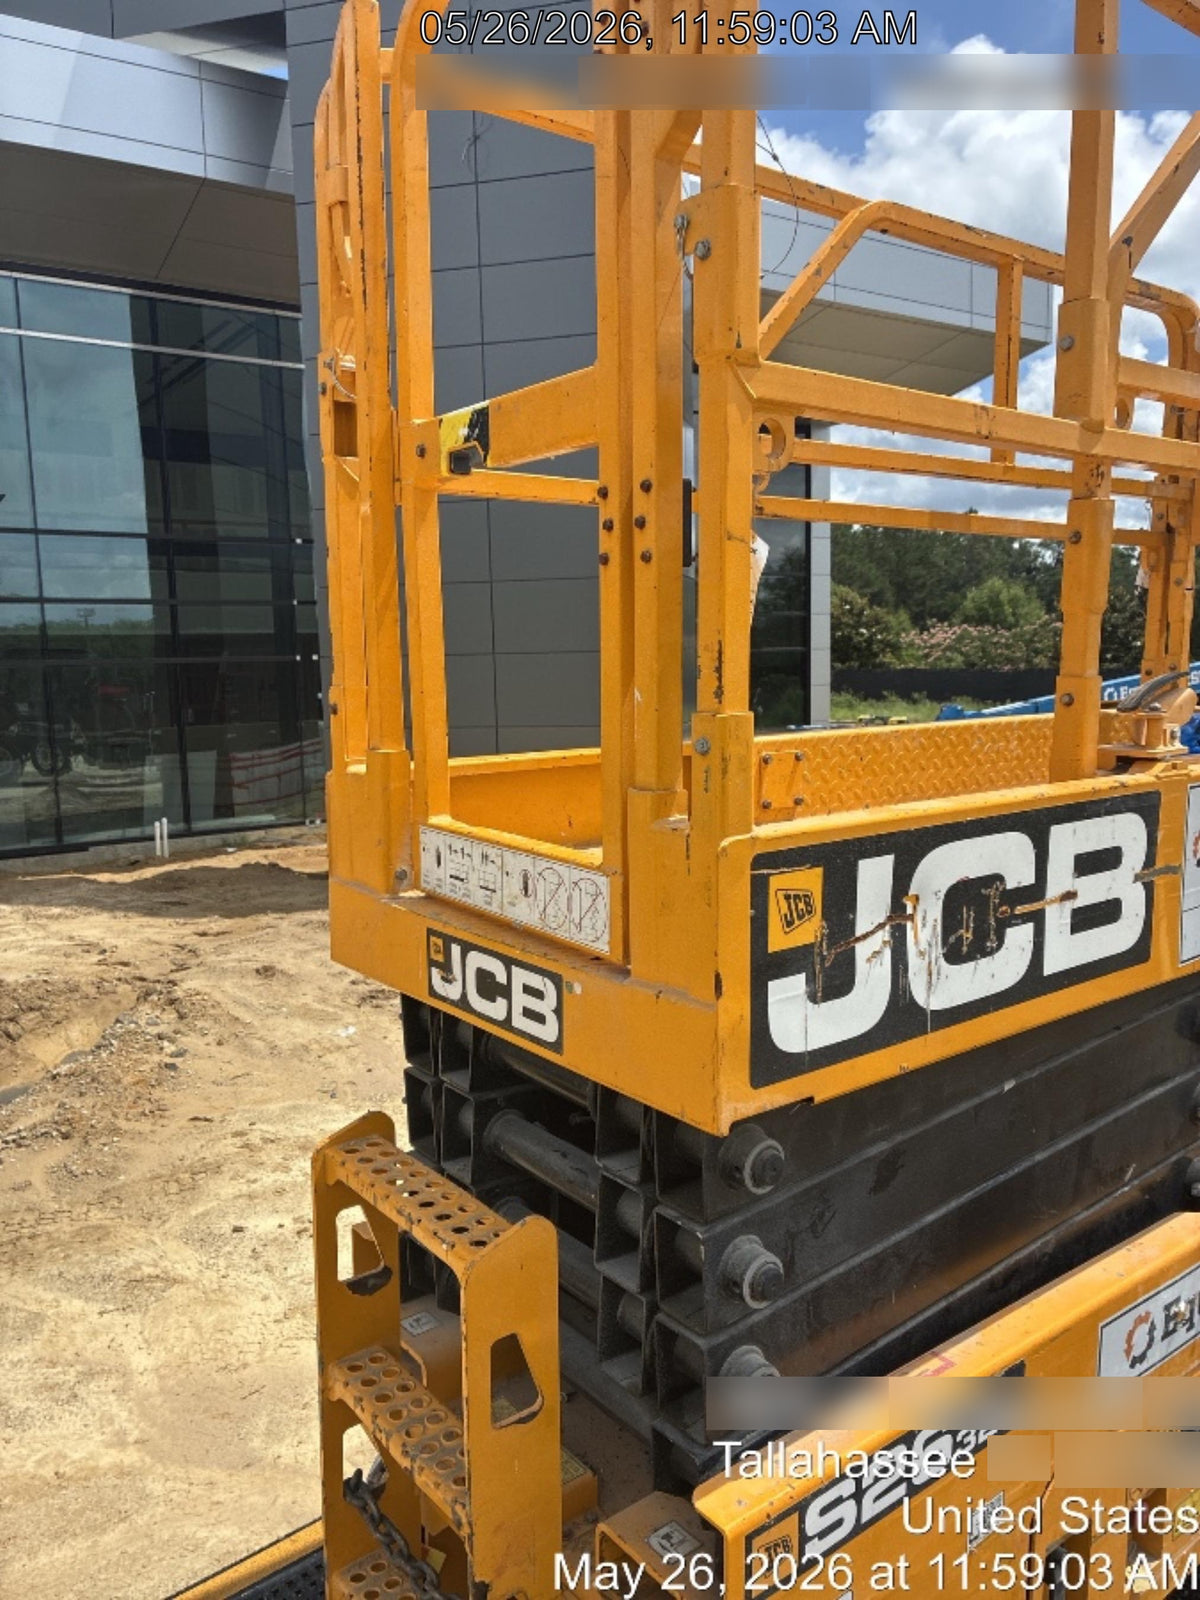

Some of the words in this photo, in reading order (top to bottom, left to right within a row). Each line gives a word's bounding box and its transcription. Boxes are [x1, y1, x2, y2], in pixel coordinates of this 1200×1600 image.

[768, 812, 1147, 1053] JCB
[783, 893, 813, 928] JCB
[431, 943, 559, 1043] JCB
